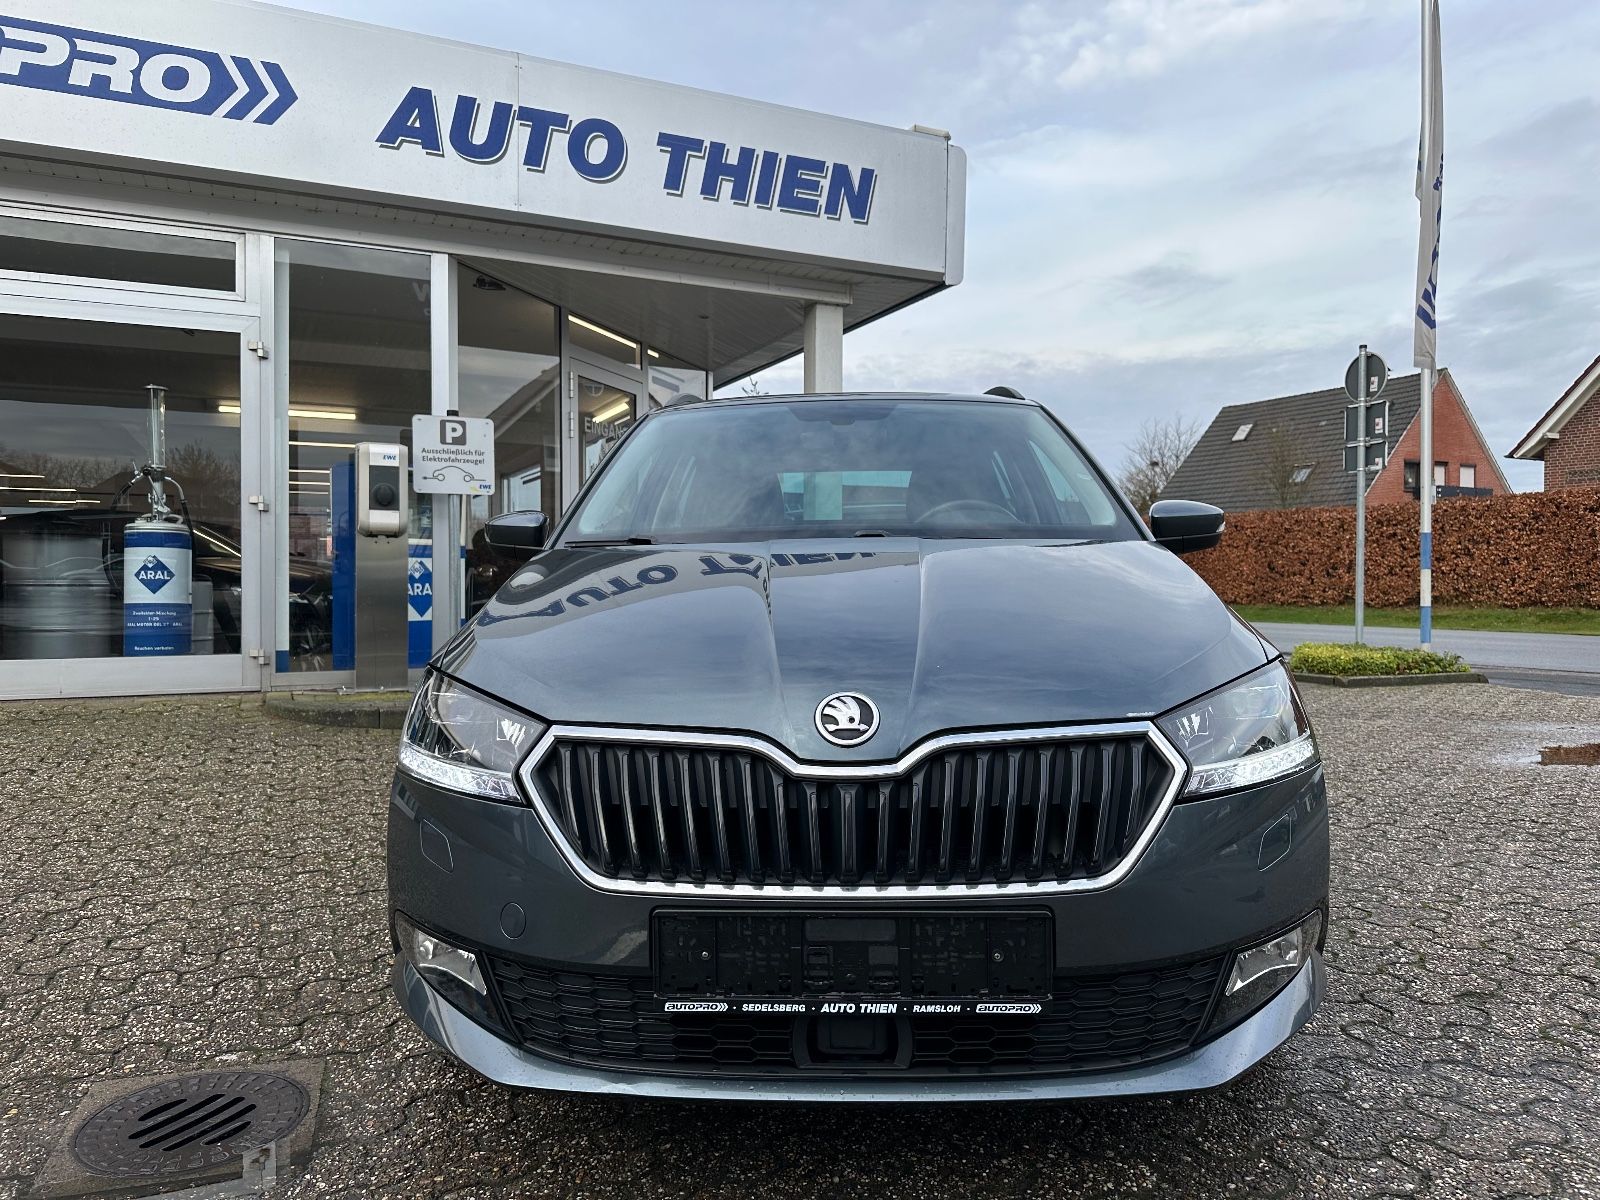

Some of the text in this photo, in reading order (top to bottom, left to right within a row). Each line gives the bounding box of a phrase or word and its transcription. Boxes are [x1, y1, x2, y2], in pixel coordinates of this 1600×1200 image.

[374, 86, 878, 224] AUTO THIEN
[445, 421, 464, 443] P
[584, 416, 628, 440] EINGAN
[421, 447, 473, 457] Ausschließlich
[422, 455, 485, 466] Elektrofahrzeuge!
[138, 570, 171, 580] ARAL
[742, 1003, 806, 1012] SEDELSBERG
[820, 1003, 856, 1013] AUTO
[860, 1003, 898, 1014] THIEN
[913, 1005, 961, 1013] RAMSLOH
